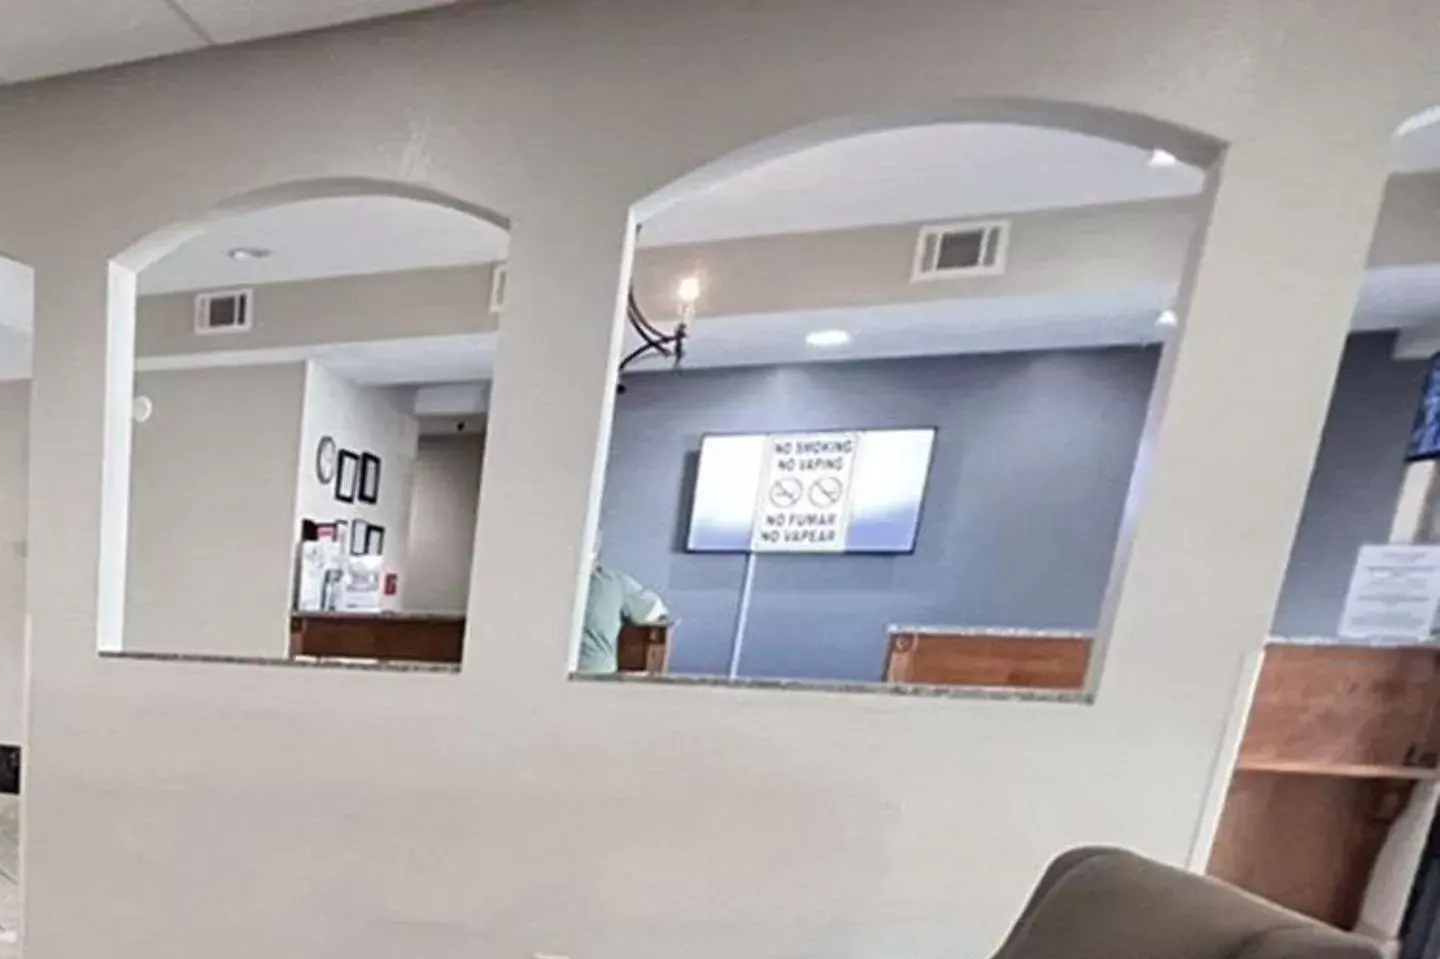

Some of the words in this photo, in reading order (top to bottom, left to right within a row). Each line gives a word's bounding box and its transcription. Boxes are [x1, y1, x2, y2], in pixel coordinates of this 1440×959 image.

[776, 442, 792, 455] NO
[795, 440, 852, 455] SMOKING
[779, 458, 795, 471] NO
[799, 457, 844, 471] VAPING
[767, 514, 786, 527] NO
[789, 512, 837, 527] FUMAR
[762, 530, 780, 543] NO
